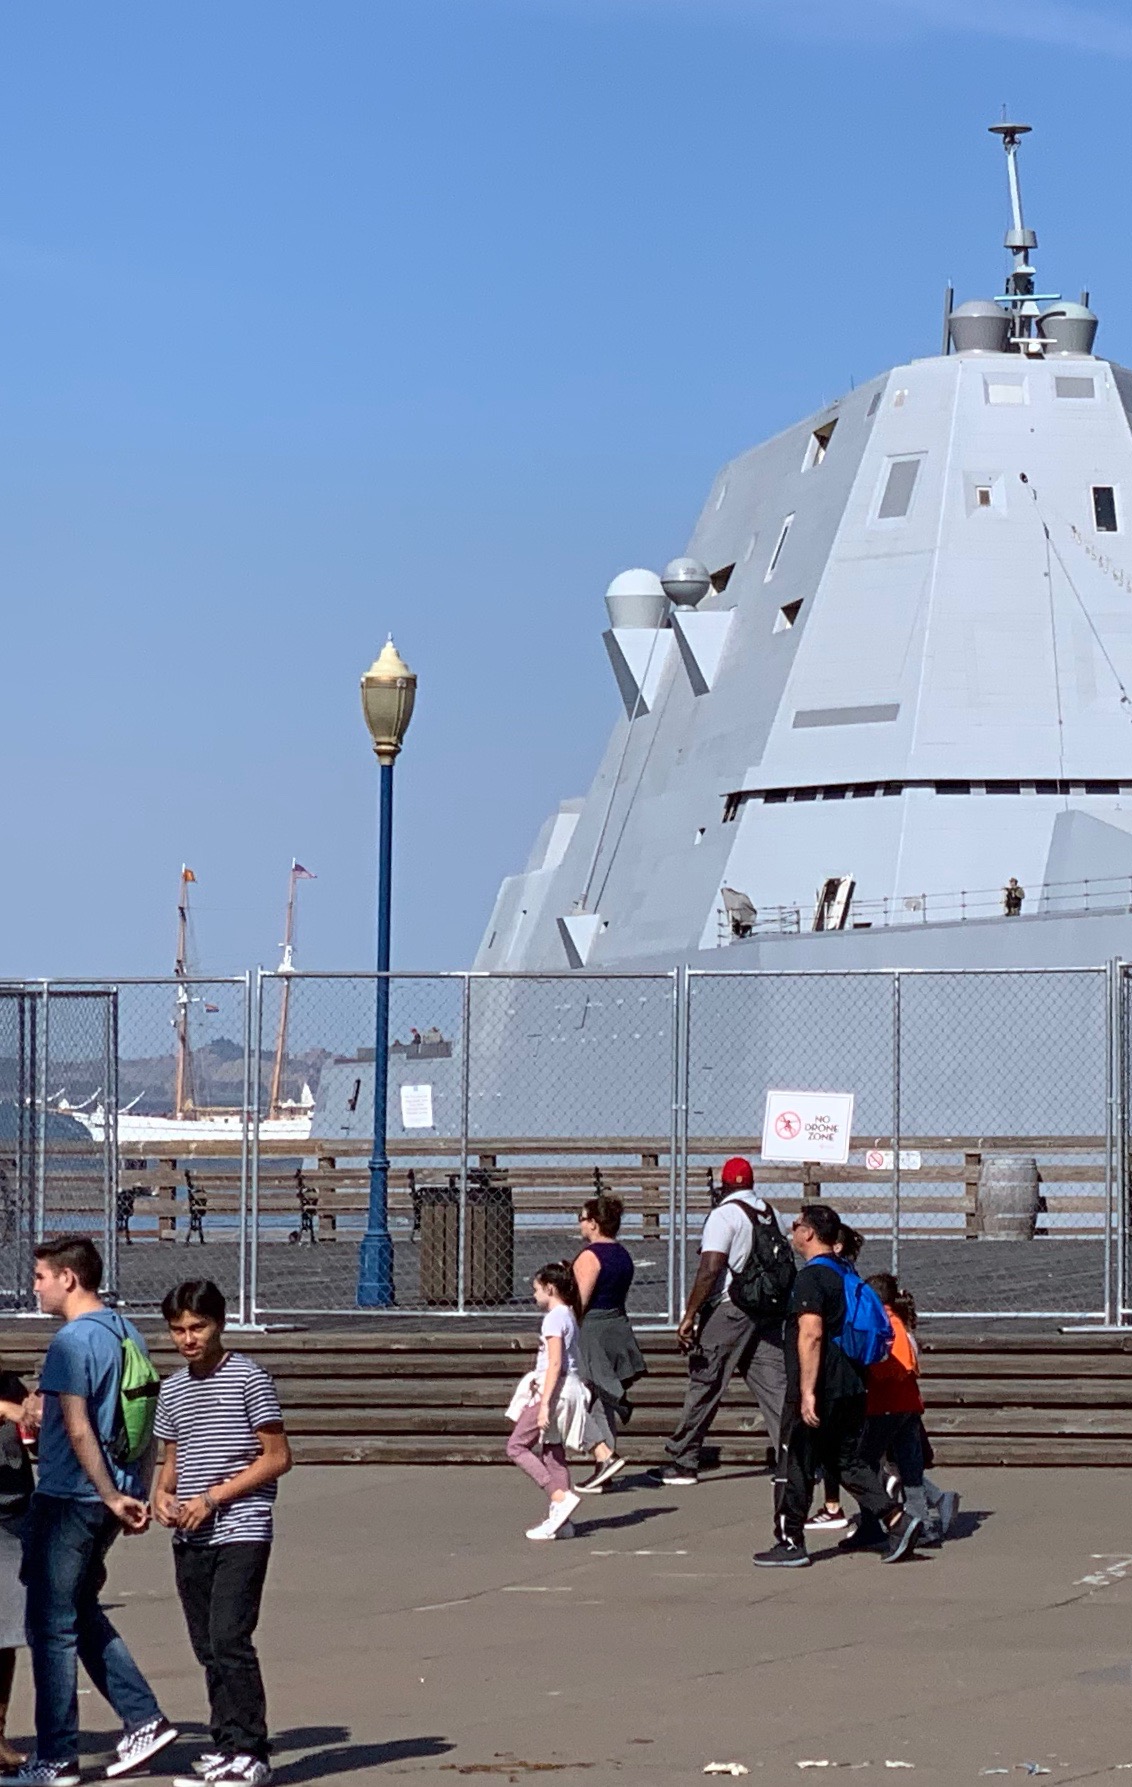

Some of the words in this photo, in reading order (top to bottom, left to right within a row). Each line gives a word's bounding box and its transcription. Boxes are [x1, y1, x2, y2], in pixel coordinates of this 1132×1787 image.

[815, 1115, 831, 1123] NO
[804, 1124, 839, 1133] DRONE
[808, 1132, 834, 1141] ZONE
